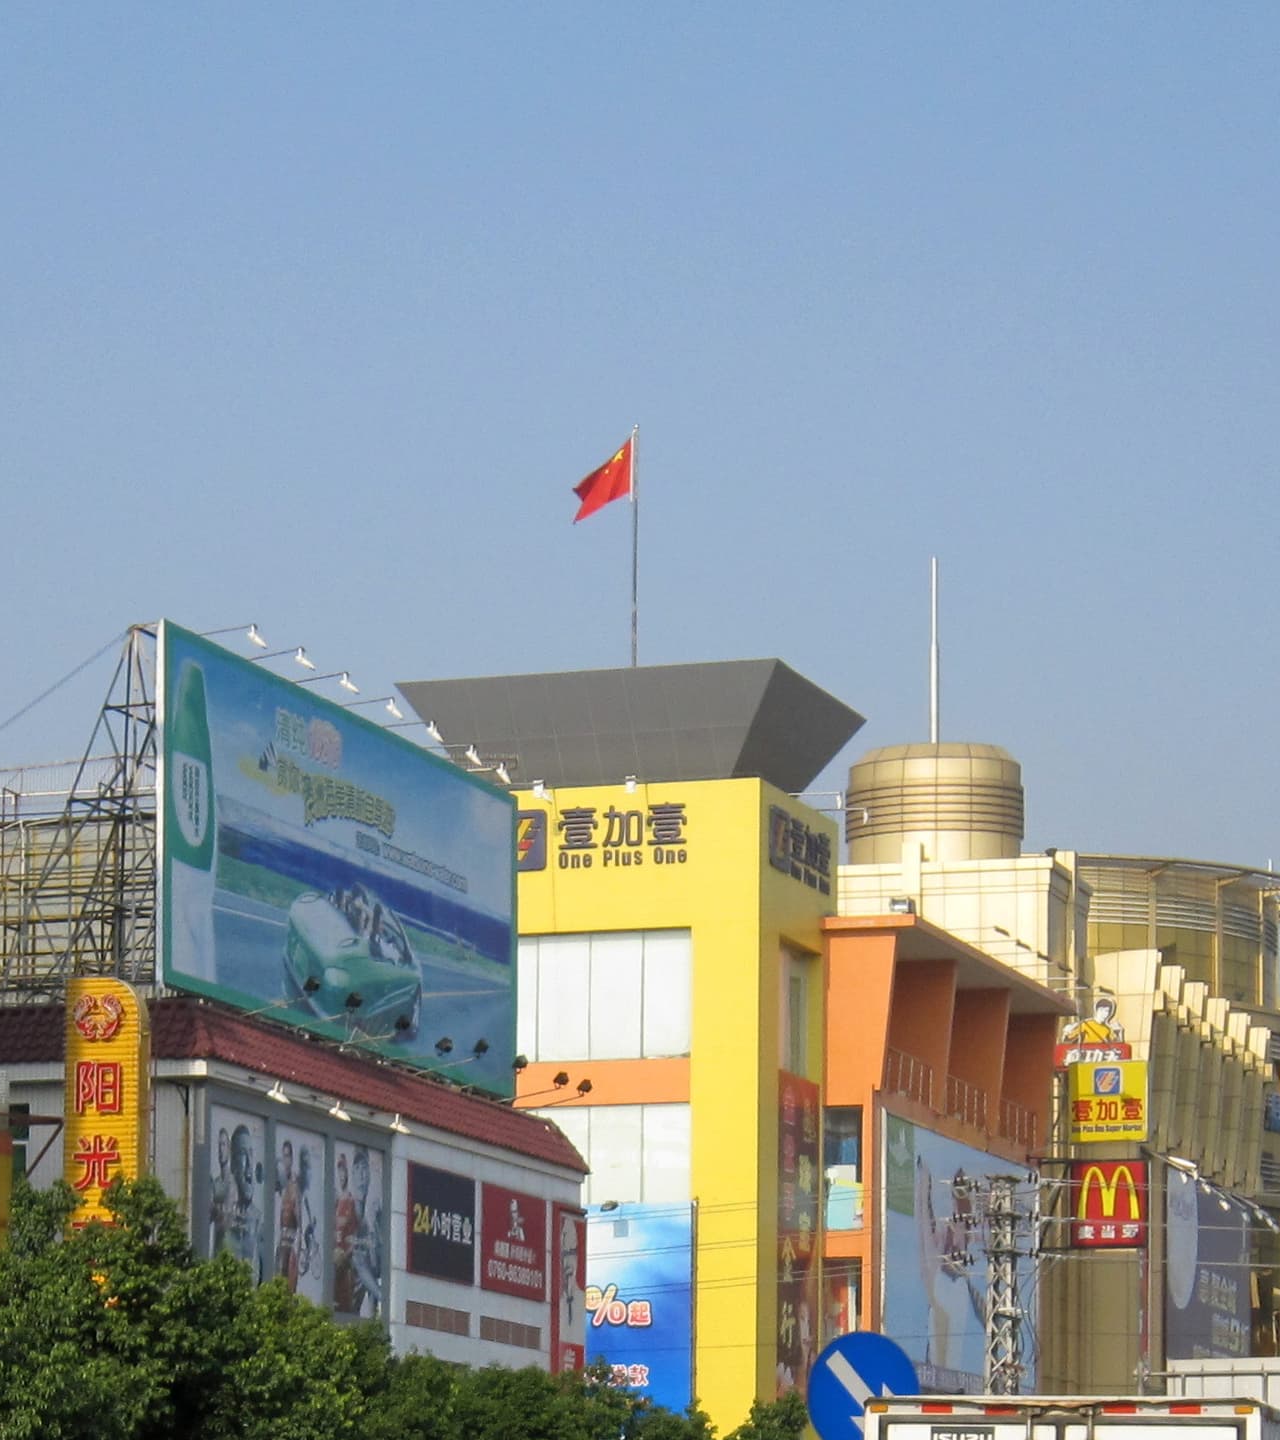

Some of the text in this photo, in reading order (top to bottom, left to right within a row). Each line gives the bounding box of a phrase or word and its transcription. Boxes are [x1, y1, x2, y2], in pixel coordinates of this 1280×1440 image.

[558, 802, 687, 850] 壹加壹
[558, 846, 687, 870] One Plus One
[1072, 1099, 1142, 1121] 壹加壹
[72, 1061, 121, 1231] 阳光
[1078, 1224, 1138, 1239] 麦当劳
